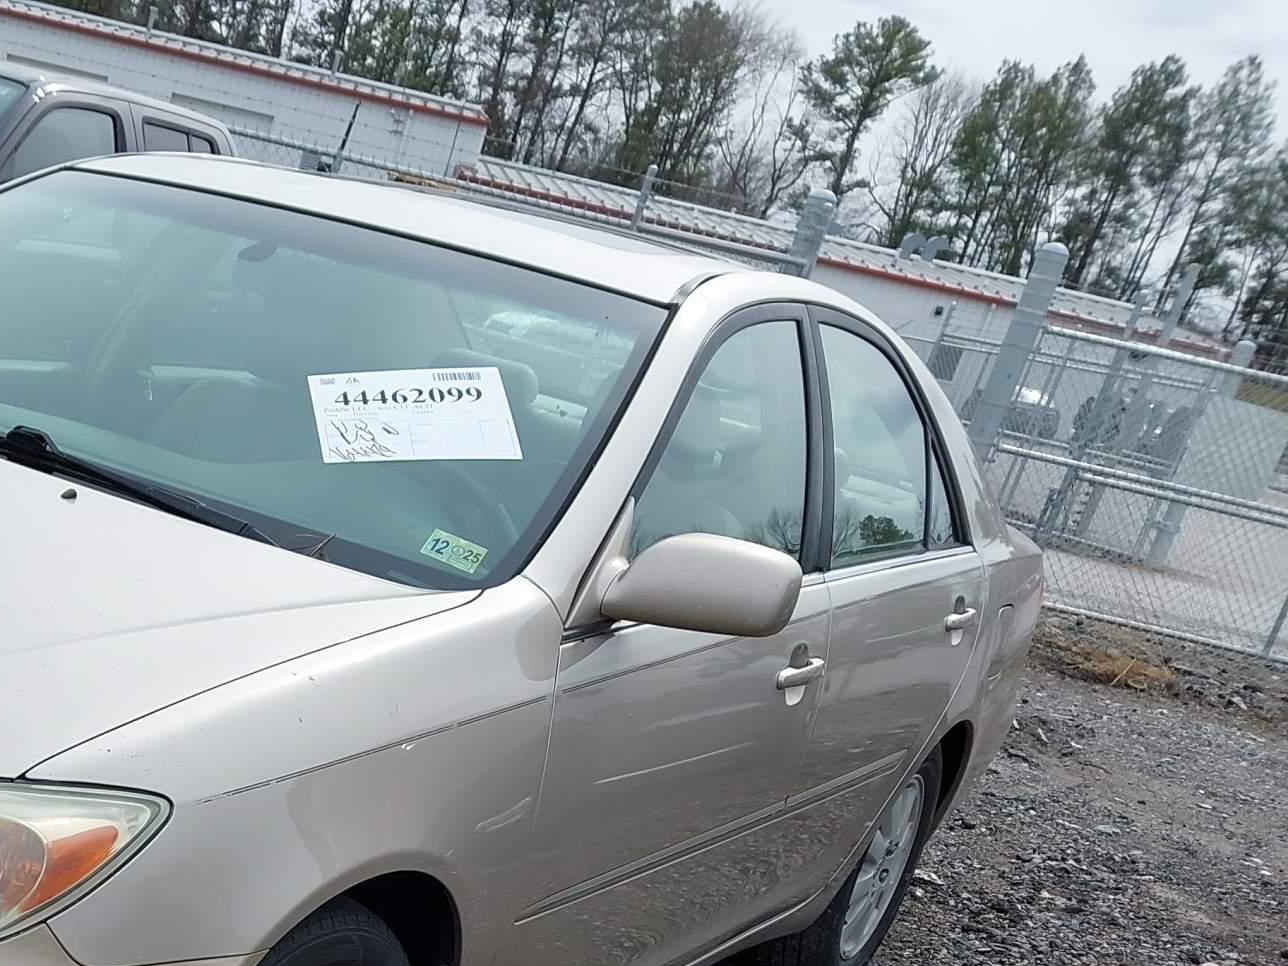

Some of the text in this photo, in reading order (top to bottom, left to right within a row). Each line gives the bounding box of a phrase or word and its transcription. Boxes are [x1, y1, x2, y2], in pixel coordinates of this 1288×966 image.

[334, 386, 483, 406] 44462099
[430, 538, 482, 564] 12 25
